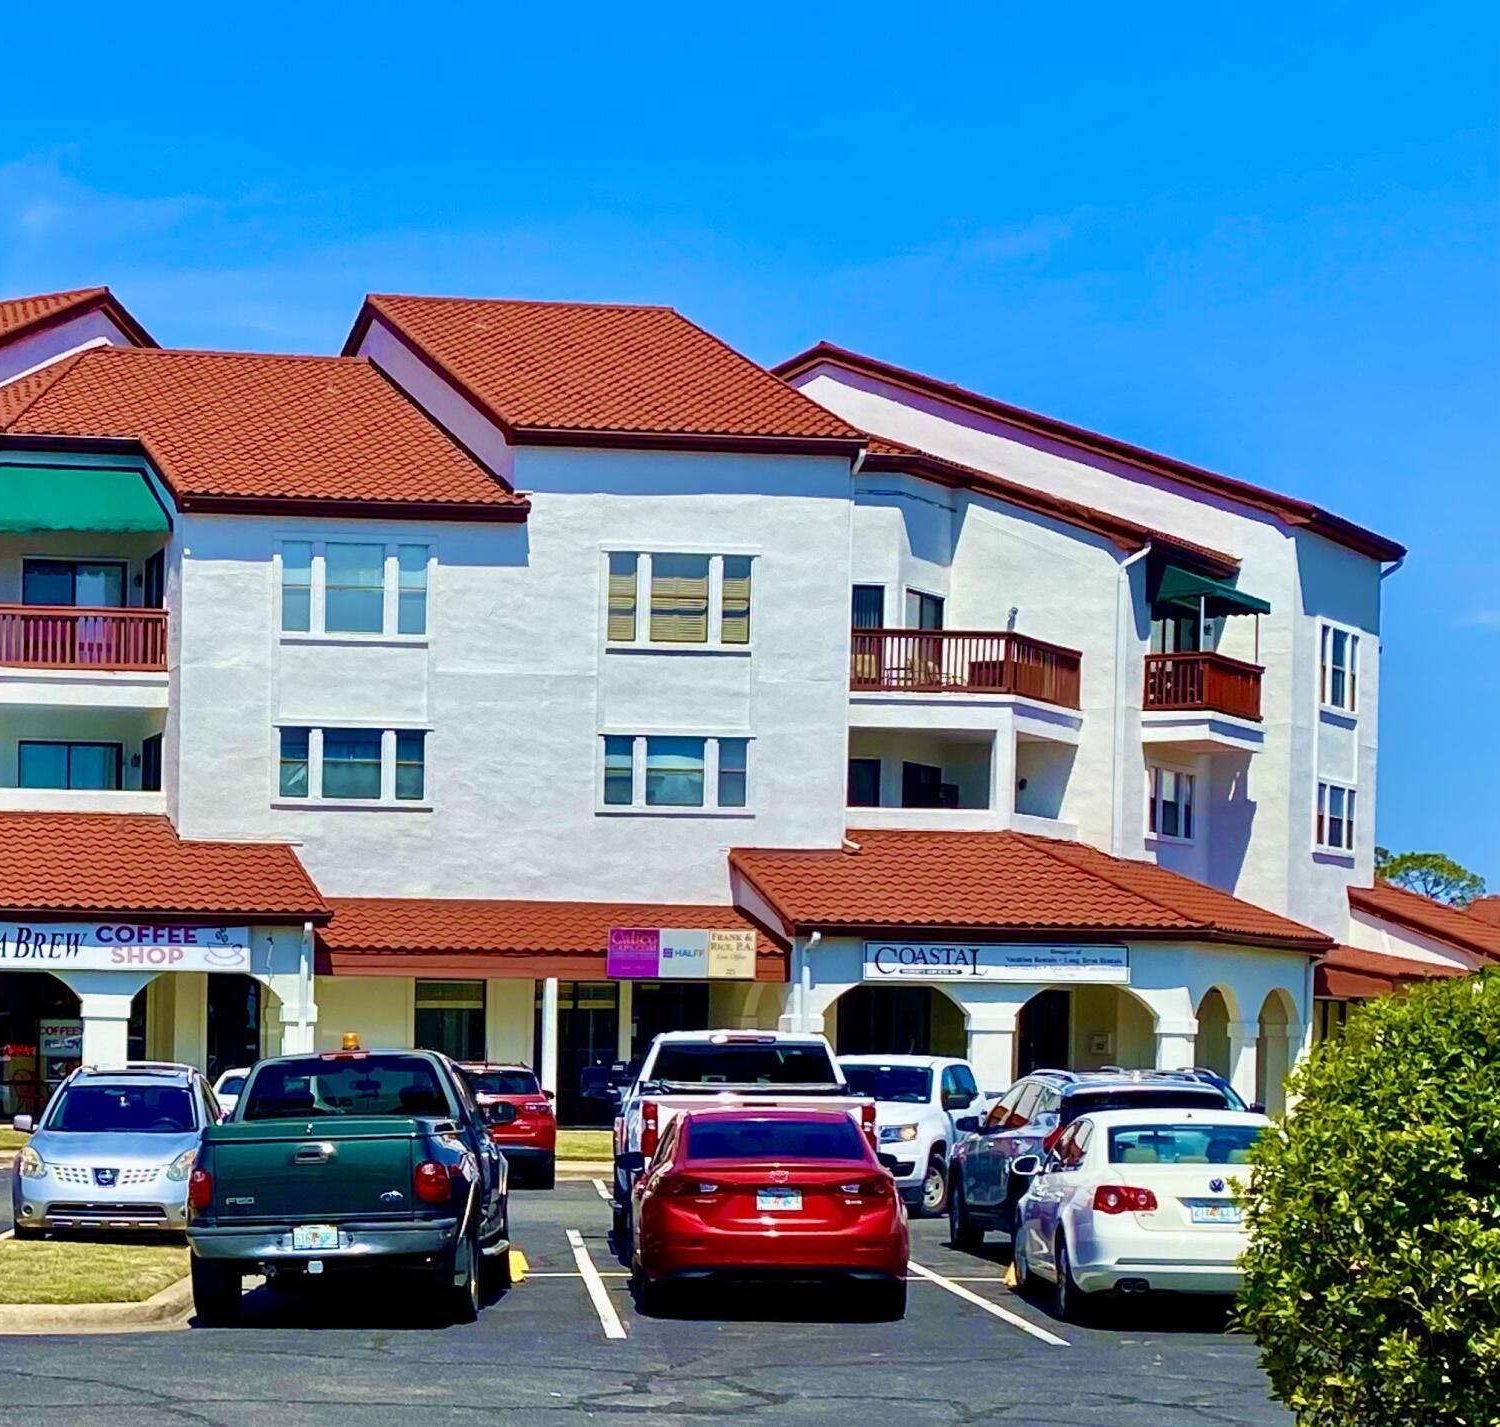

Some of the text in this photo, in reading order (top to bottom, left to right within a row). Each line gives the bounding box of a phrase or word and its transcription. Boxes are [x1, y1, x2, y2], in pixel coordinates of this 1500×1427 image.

[12, 927, 88, 960] BREW
[95, 925, 198, 944] COFFEE
[711, 932, 742, 941] FRANK
[111, 946, 185, 965] SHOP
[675, 950, 704, 958] HALFF
[875, 946, 989, 976] COASTAL
